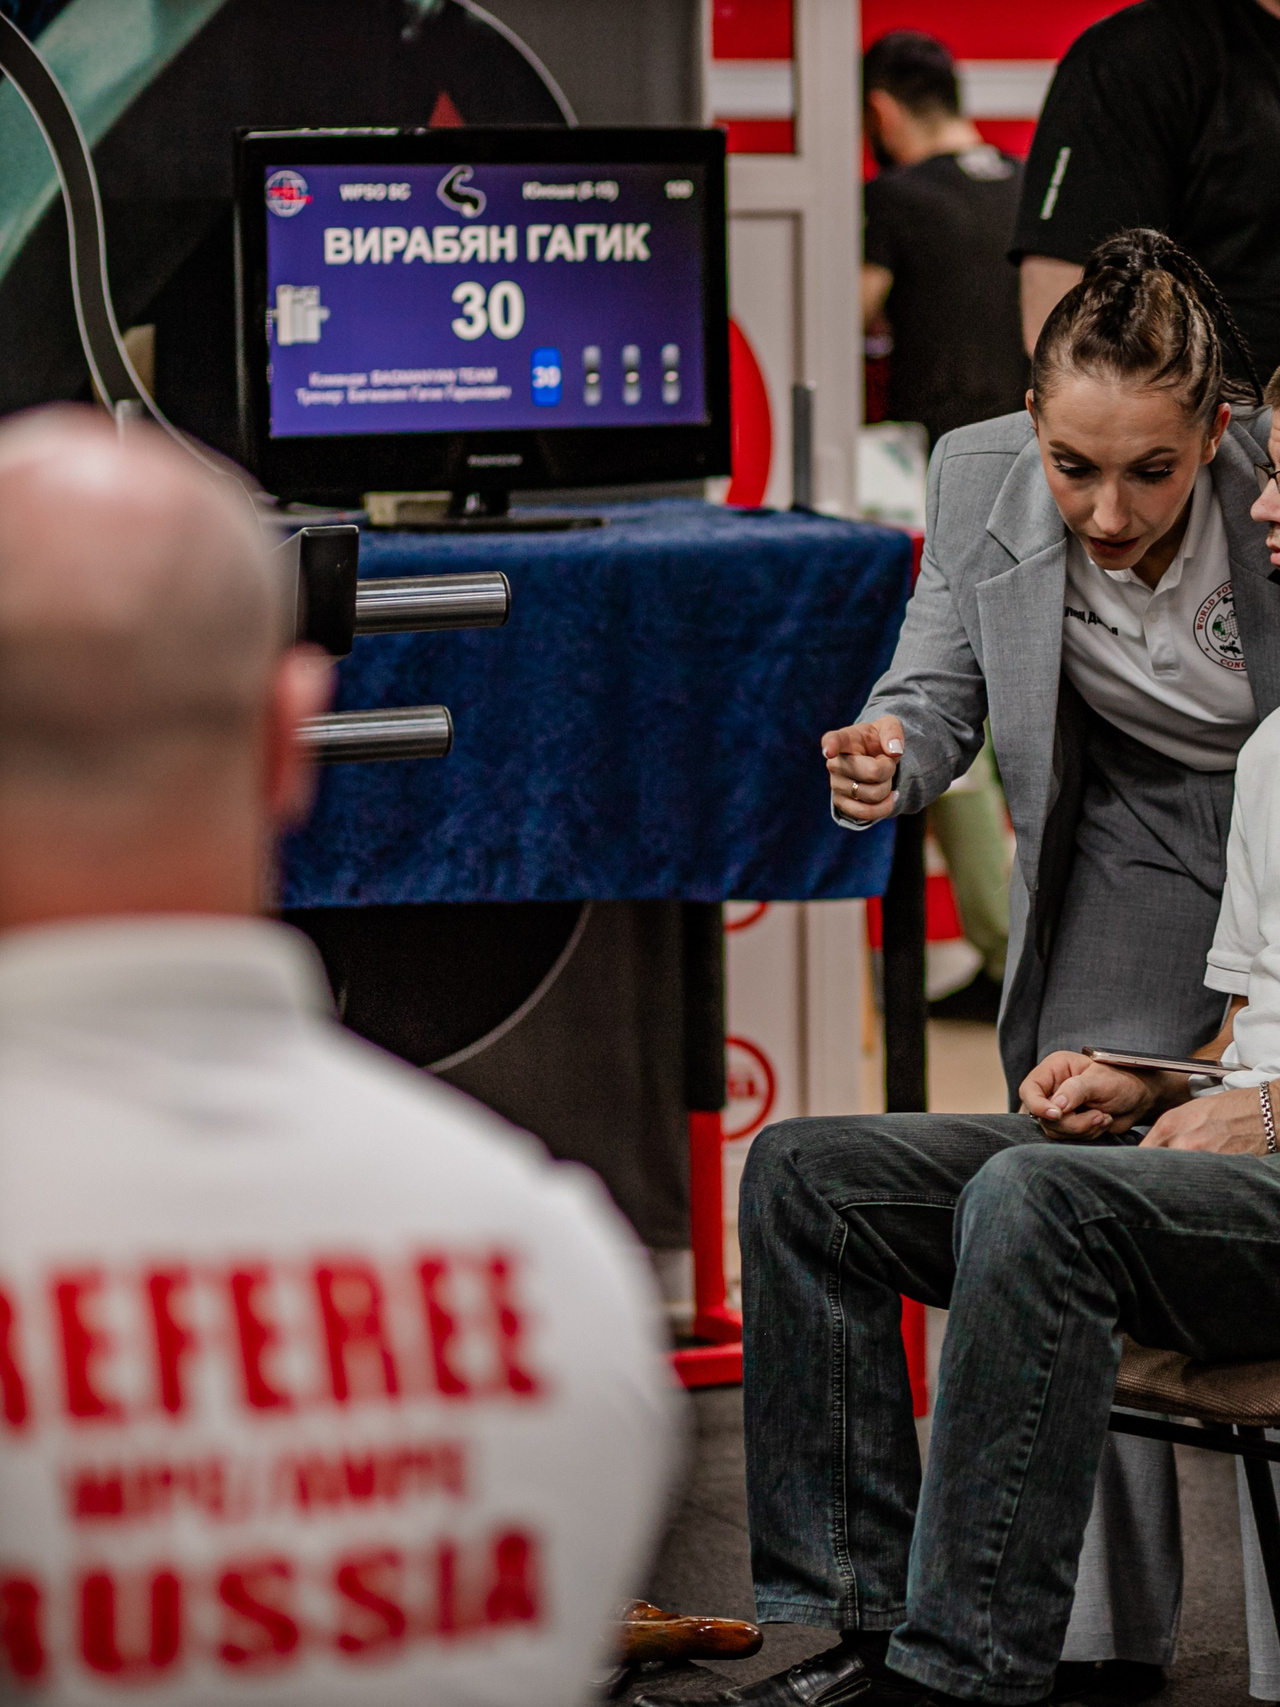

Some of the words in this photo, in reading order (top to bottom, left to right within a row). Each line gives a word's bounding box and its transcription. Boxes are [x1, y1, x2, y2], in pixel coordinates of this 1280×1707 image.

[324, 224, 517, 264] ВИРАБЯН
[527, 223, 652, 262] ГАГИК
[451, 280, 525, 341] 30
[532, 366, 561, 389] 30
[1197, 599, 1216, 631] WORLD
